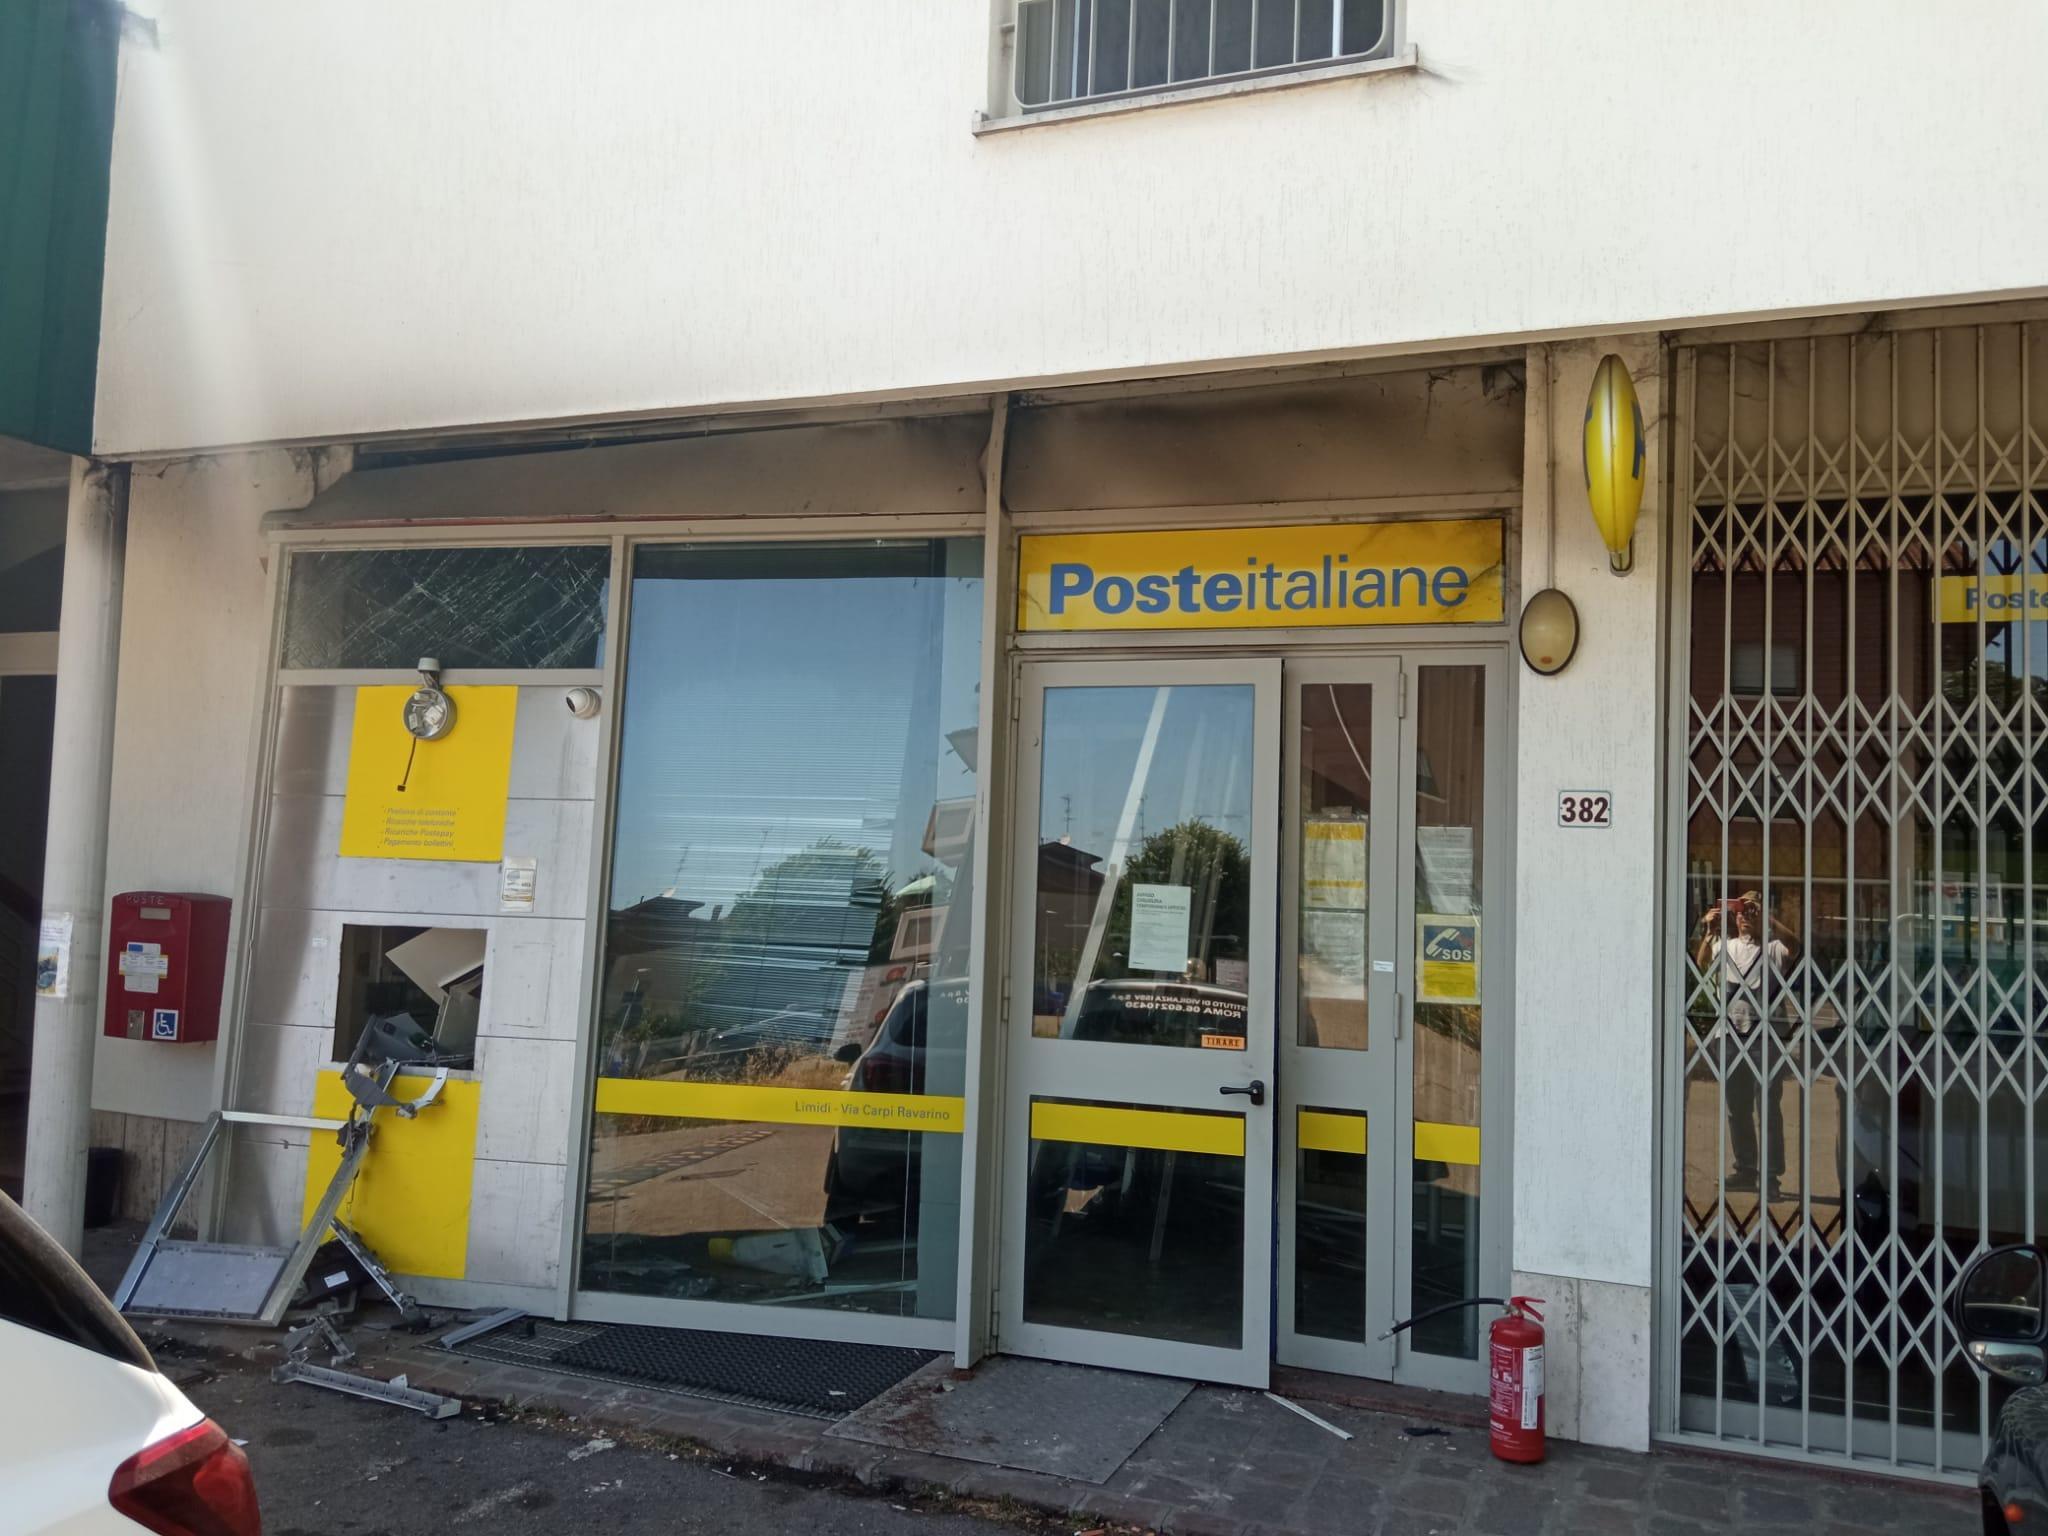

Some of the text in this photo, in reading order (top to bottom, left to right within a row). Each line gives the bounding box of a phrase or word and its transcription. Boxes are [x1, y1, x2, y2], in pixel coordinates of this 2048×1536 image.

[1049, 553, 1469, 615] Posteitaliane
[1561, 796, 1609, 823] 382
[126, 895, 165, 905] POSTE
[1442, 948, 1472, 961] SOS
[1206, 1036, 1240, 1048] TIRARE
[795, 1101, 831, 1113] Limidi
[841, 1103, 859, 1115] Via
[862, 1104, 894, 1119] Carpi
[897, 1106, 950, 1121] Ravarino
